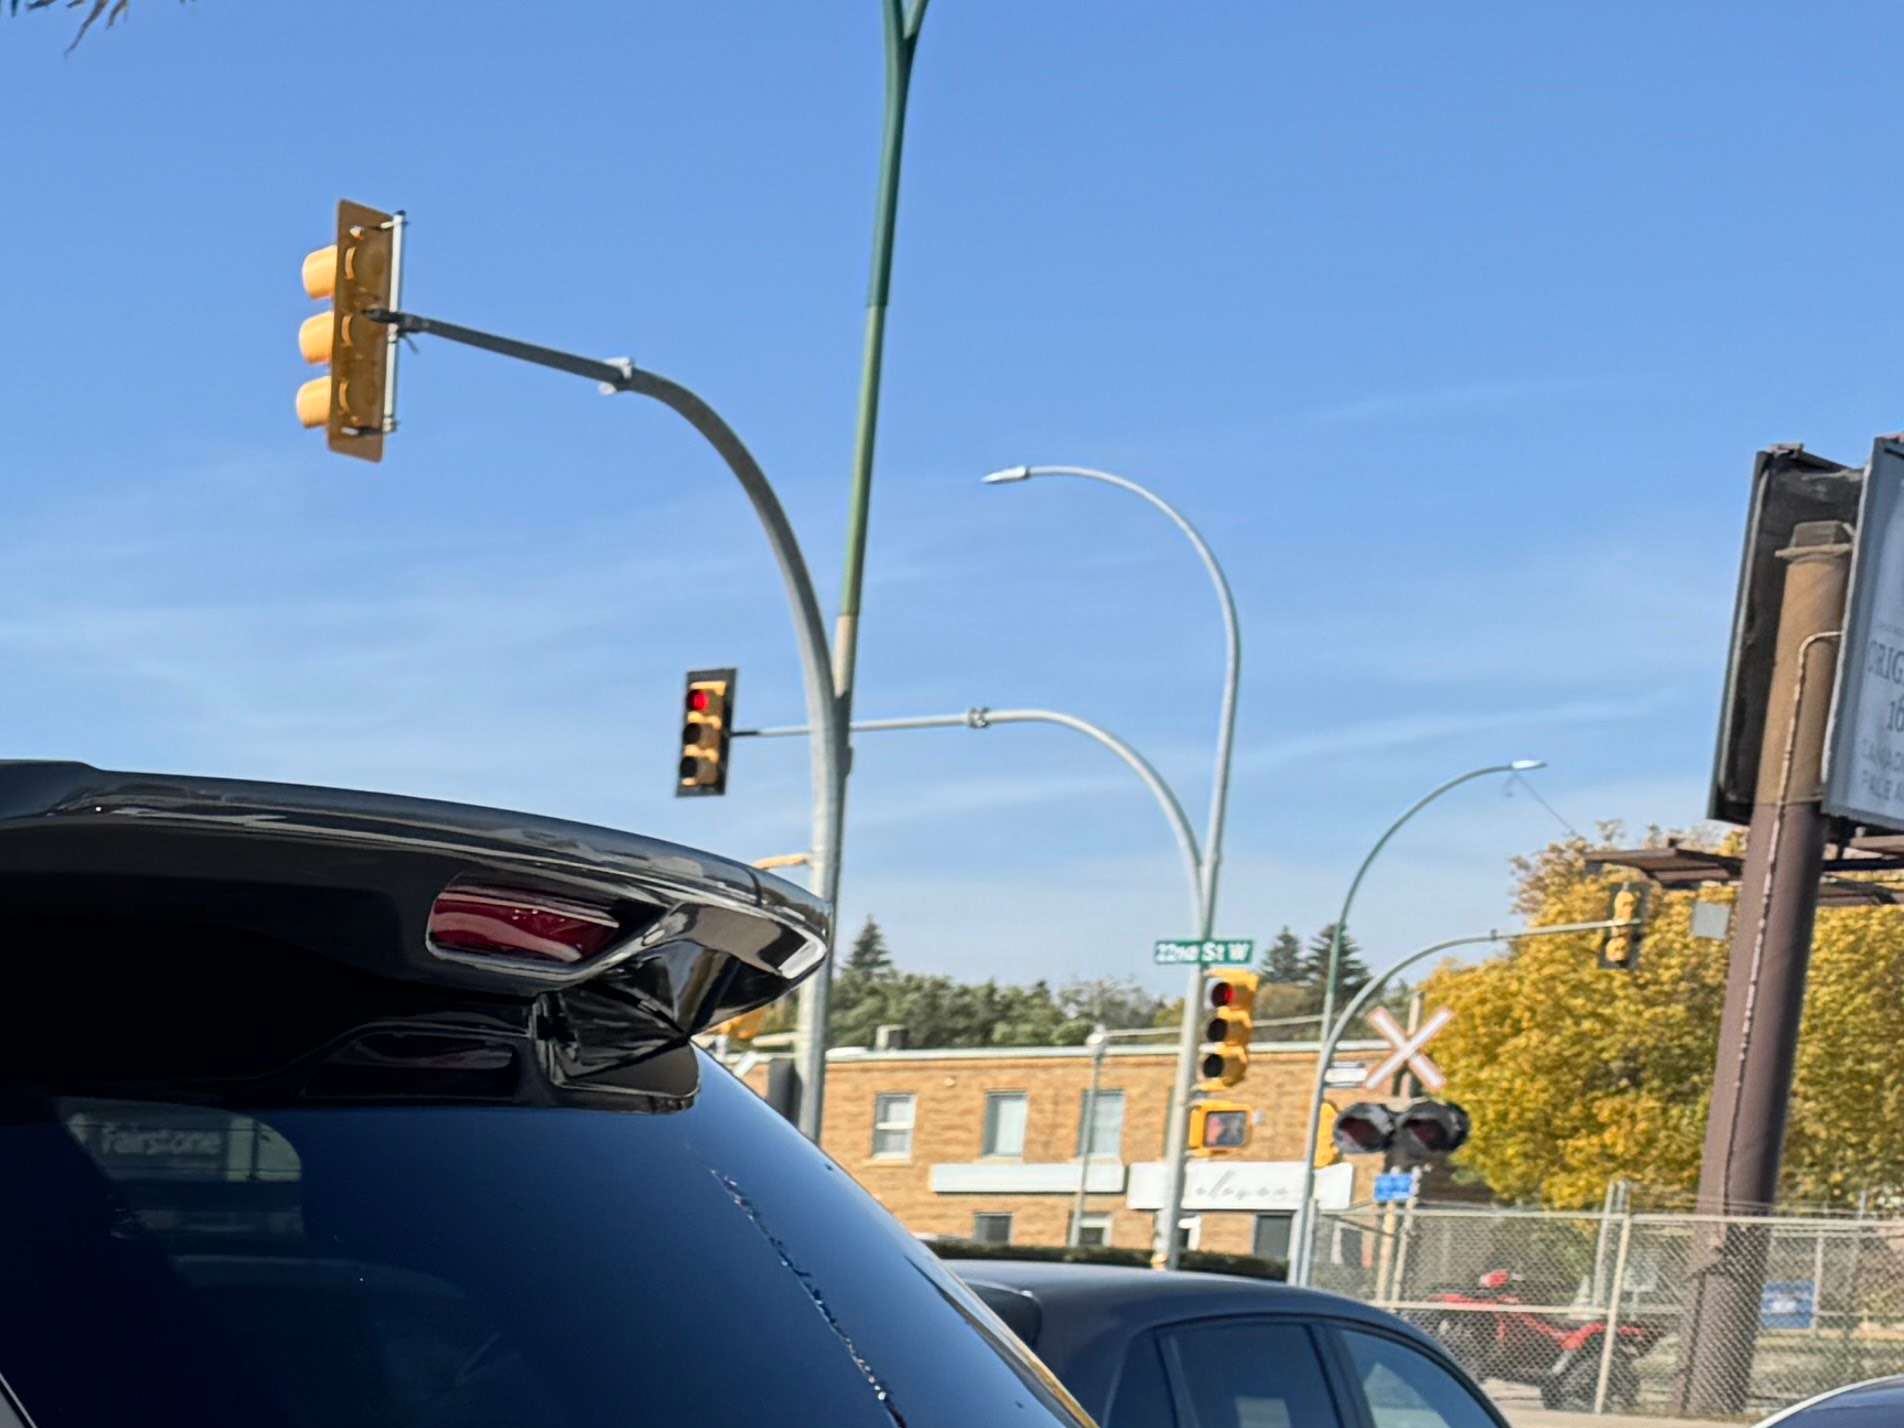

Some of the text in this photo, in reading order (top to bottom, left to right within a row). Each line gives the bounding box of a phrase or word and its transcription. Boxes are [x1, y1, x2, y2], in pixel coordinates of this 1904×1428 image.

[1155, 941, 1250, 962] 22nd St W
